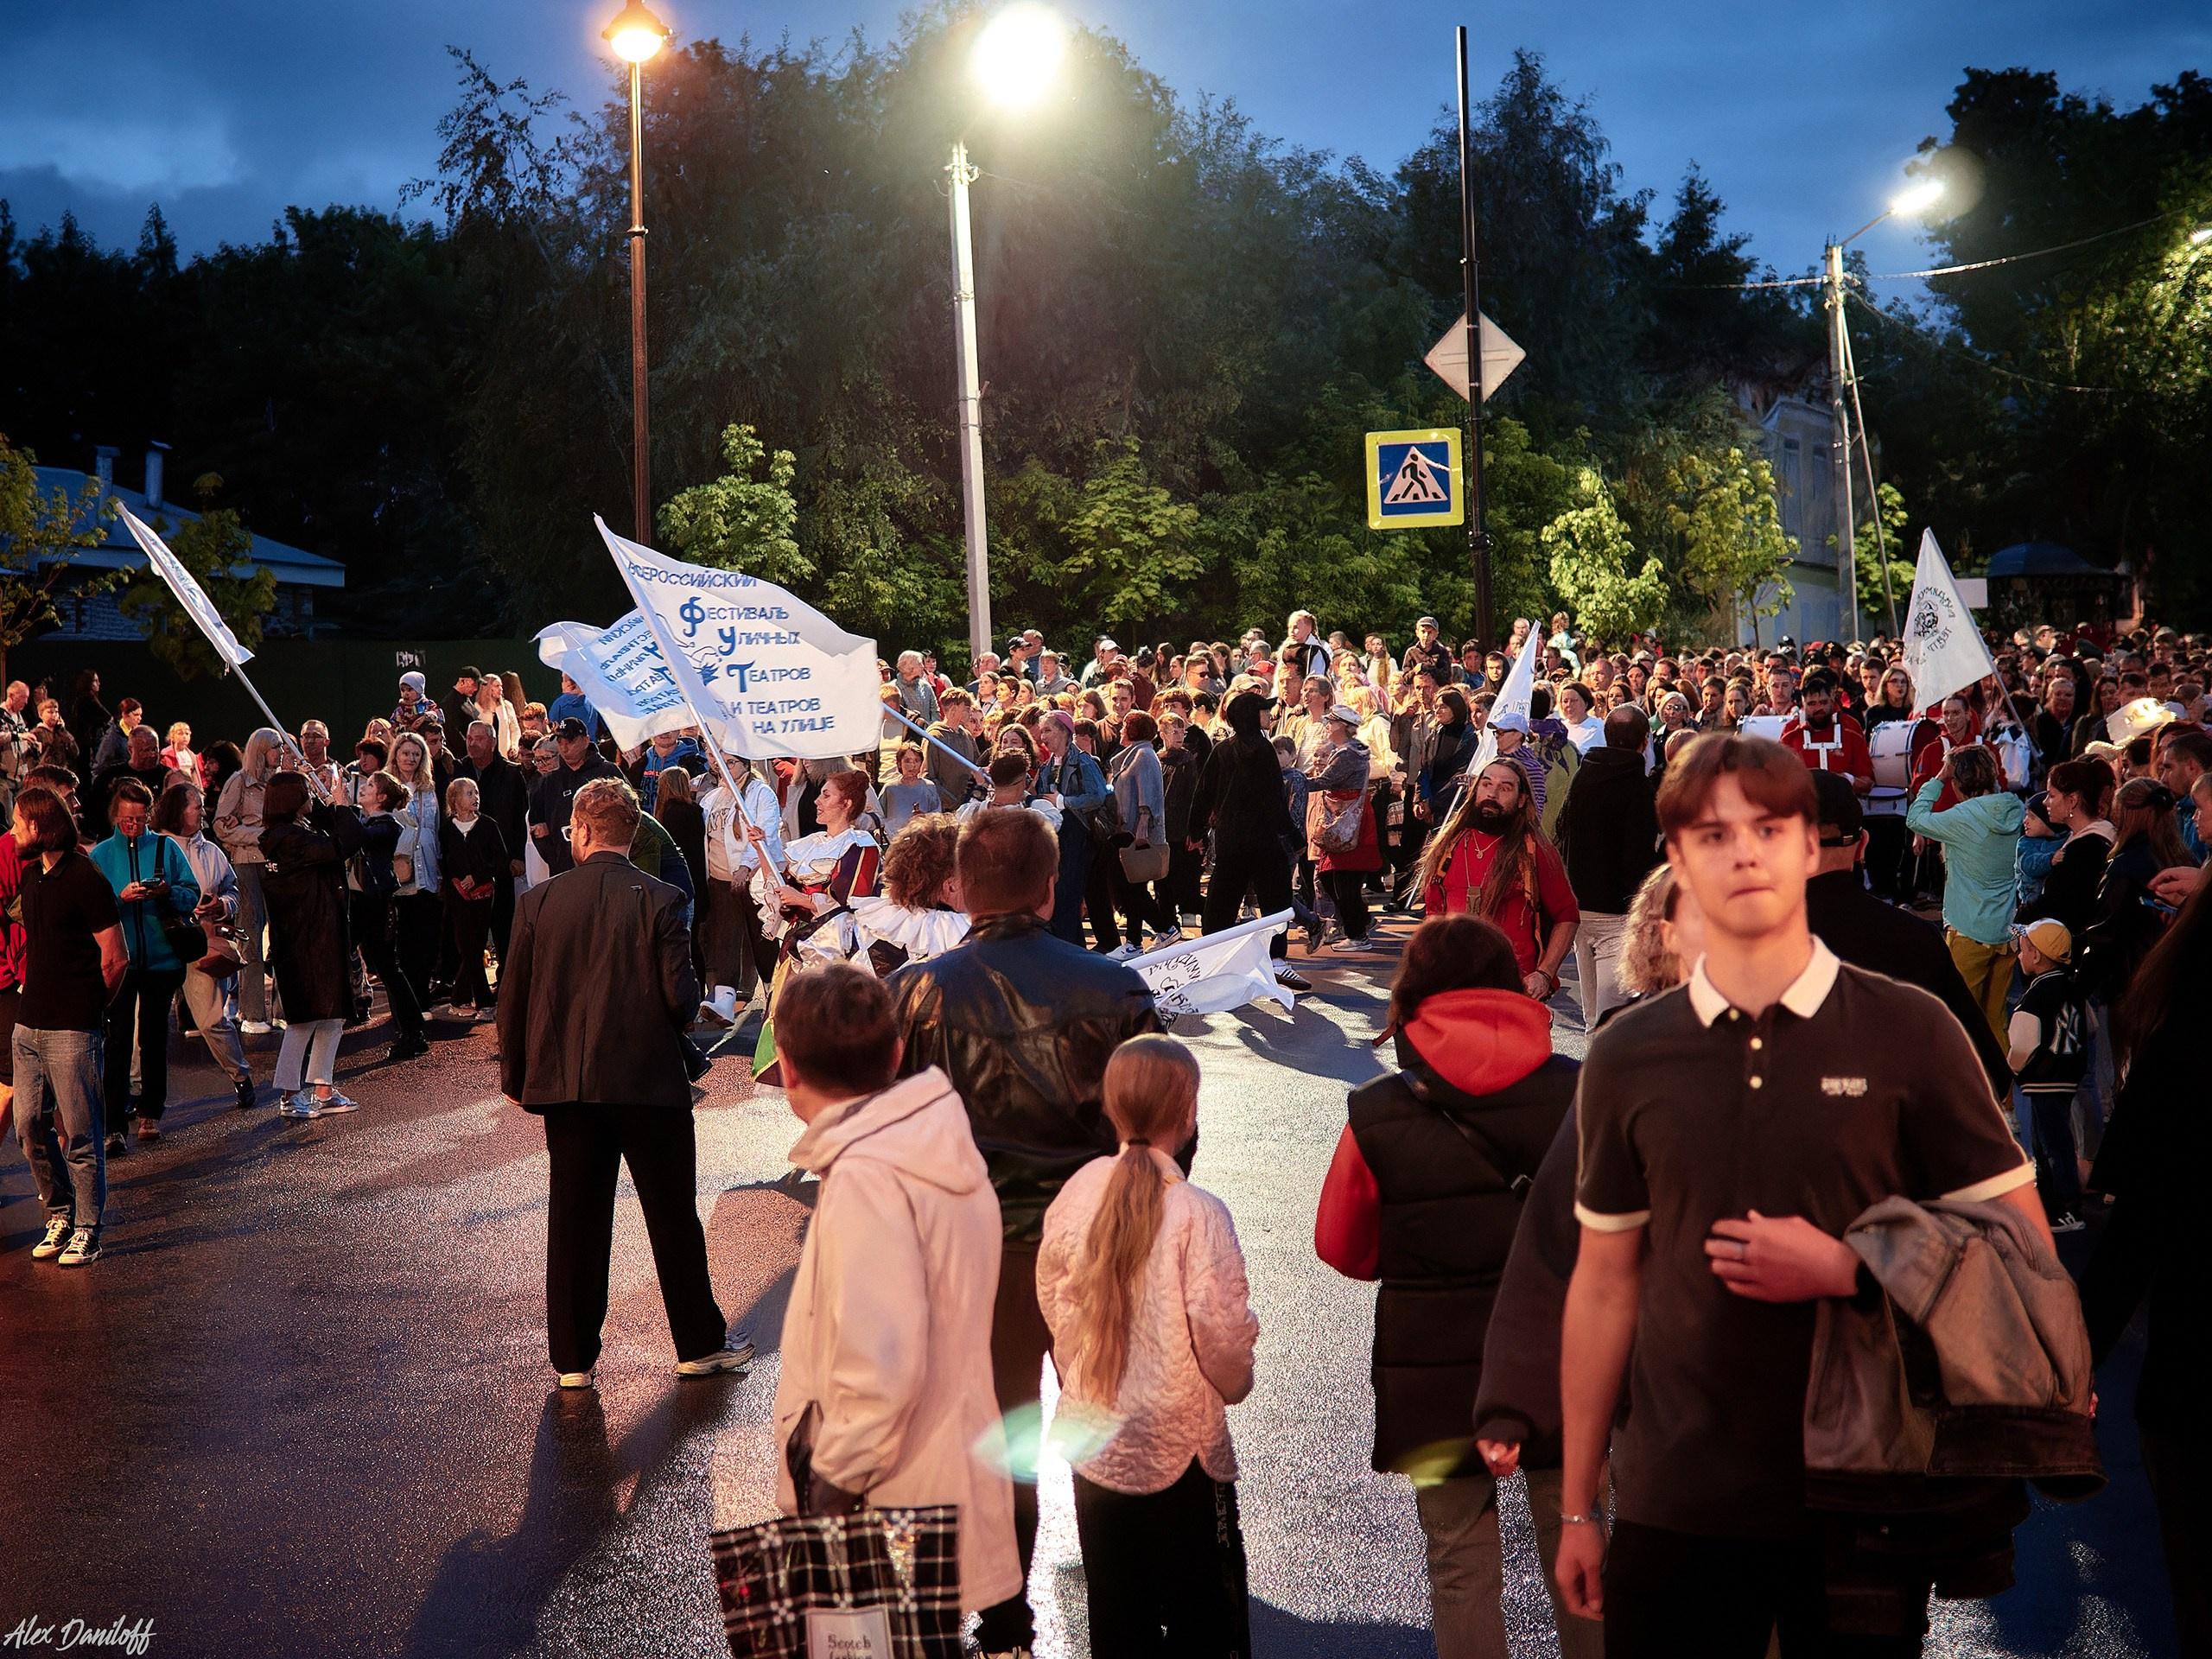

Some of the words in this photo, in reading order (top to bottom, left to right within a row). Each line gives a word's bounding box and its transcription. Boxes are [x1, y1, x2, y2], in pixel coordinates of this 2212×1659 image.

[679, 596, 790, 638] ФЕСТИВАЛЬ
[717, 626, 800, 656] УЛИЧНЫХ
[726, 660, 811, 693] ТЕАТРОВ
[747, 697, 821, 715] ТЕАТРОВ
[753, 720, 777, 734] НА
[781, 715, 835, 734] УЛИЦЕ
[2049, 1001, 2082, 1055] NY
